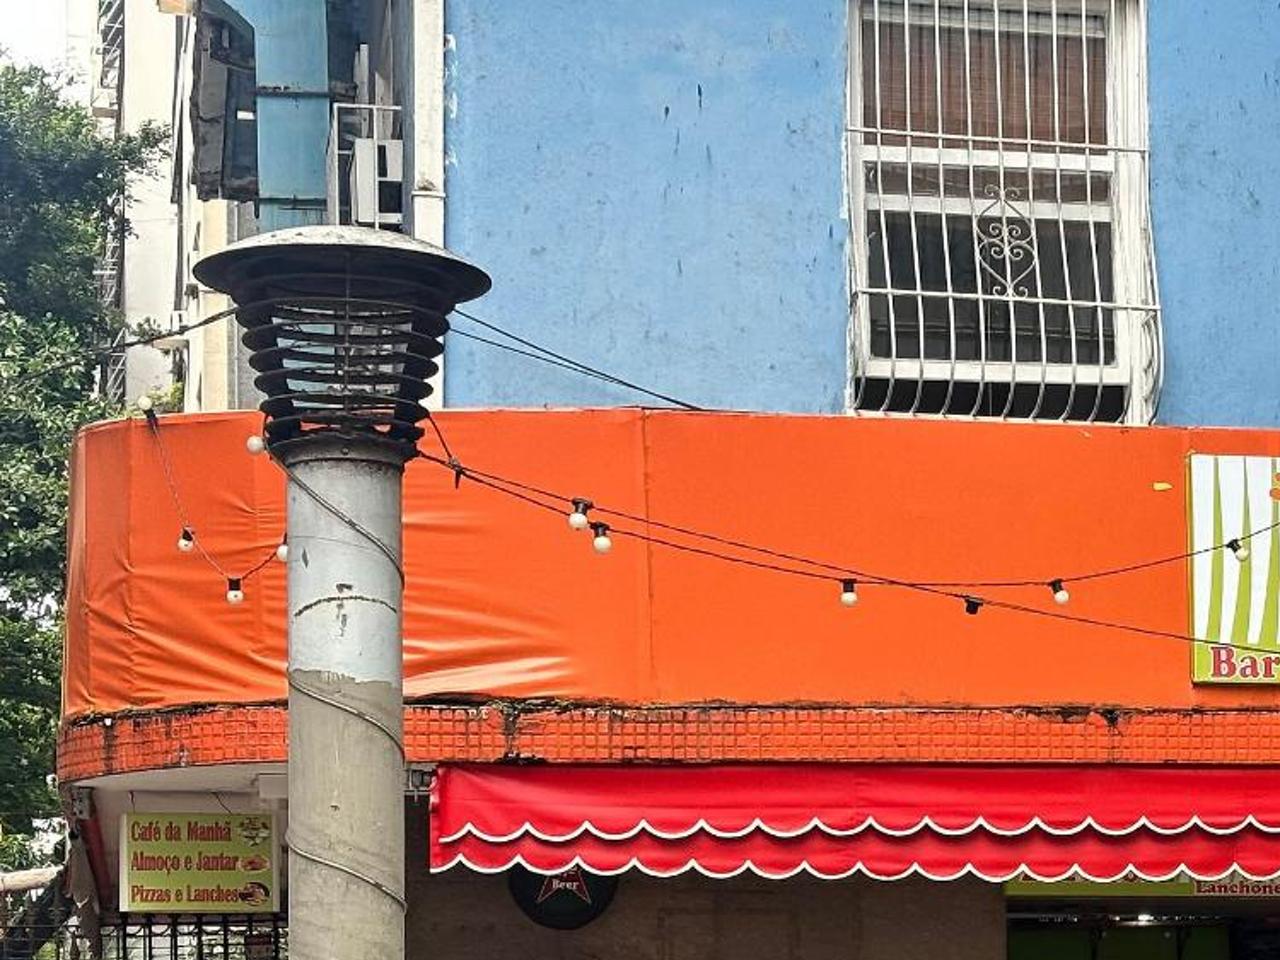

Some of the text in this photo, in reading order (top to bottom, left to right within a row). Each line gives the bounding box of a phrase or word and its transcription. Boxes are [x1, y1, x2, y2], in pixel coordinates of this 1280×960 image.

[131, 819, 231, 842] Café da Manhã
[131, 850, 239, 875] Almoço e Jantar
[131, 884, 240, 904] Pizzas e Lanches
[552, 878, 579, 890] Beer
